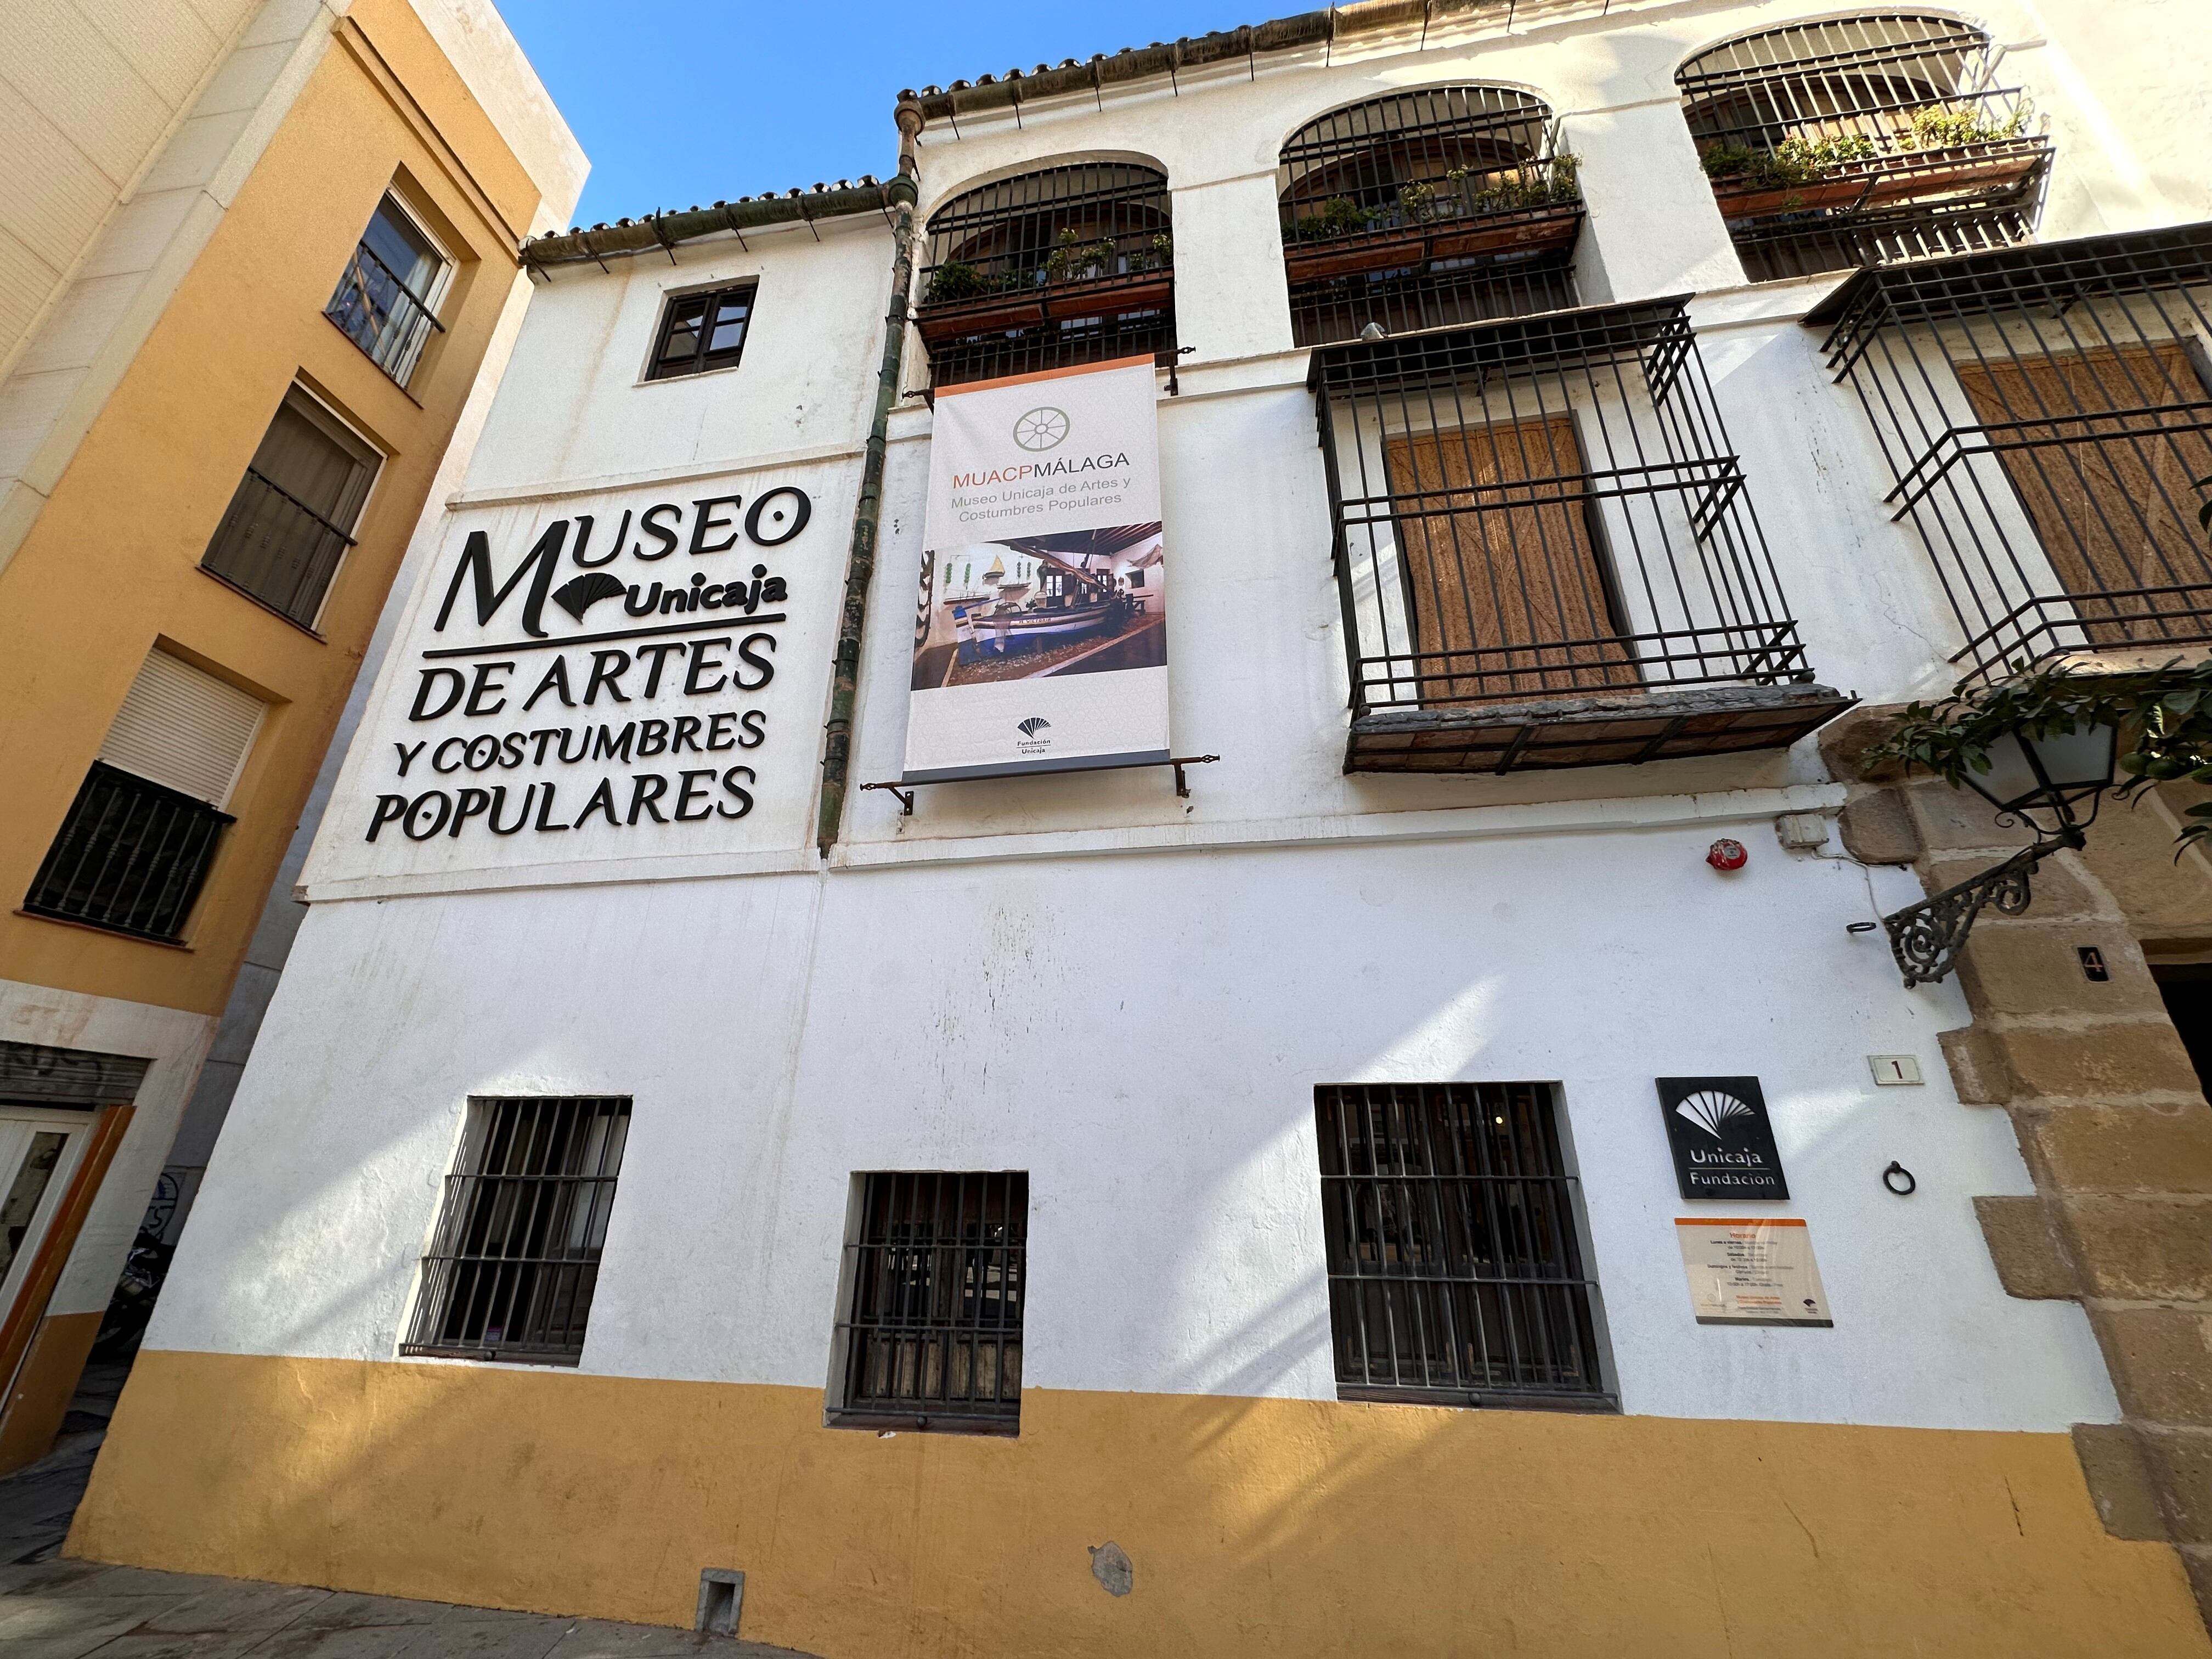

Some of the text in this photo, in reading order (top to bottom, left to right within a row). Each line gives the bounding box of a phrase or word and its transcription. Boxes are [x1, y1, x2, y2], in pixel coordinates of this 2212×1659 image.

[951, 477, 1131, 509] Museo Unicaja de Artes y
[959, 494, 1122, 522] Costumbres Populares
[433, 486, 812, 638] MUSEO
[623, 563, 788, 617] Unicaja
[408, 633, 776, 721] DE ARTES
[393, 709, 766, 777] Y COSTUMBRES
[365, 765, 757, 843] POPULARES
[2084, 952, 2103, 973] 4
[1891, 1060, 1903, 1079] 1
[1690, 1147, 1763, 1167] Unicaja
[1689, 1171, 1775, 1186] Fundación
